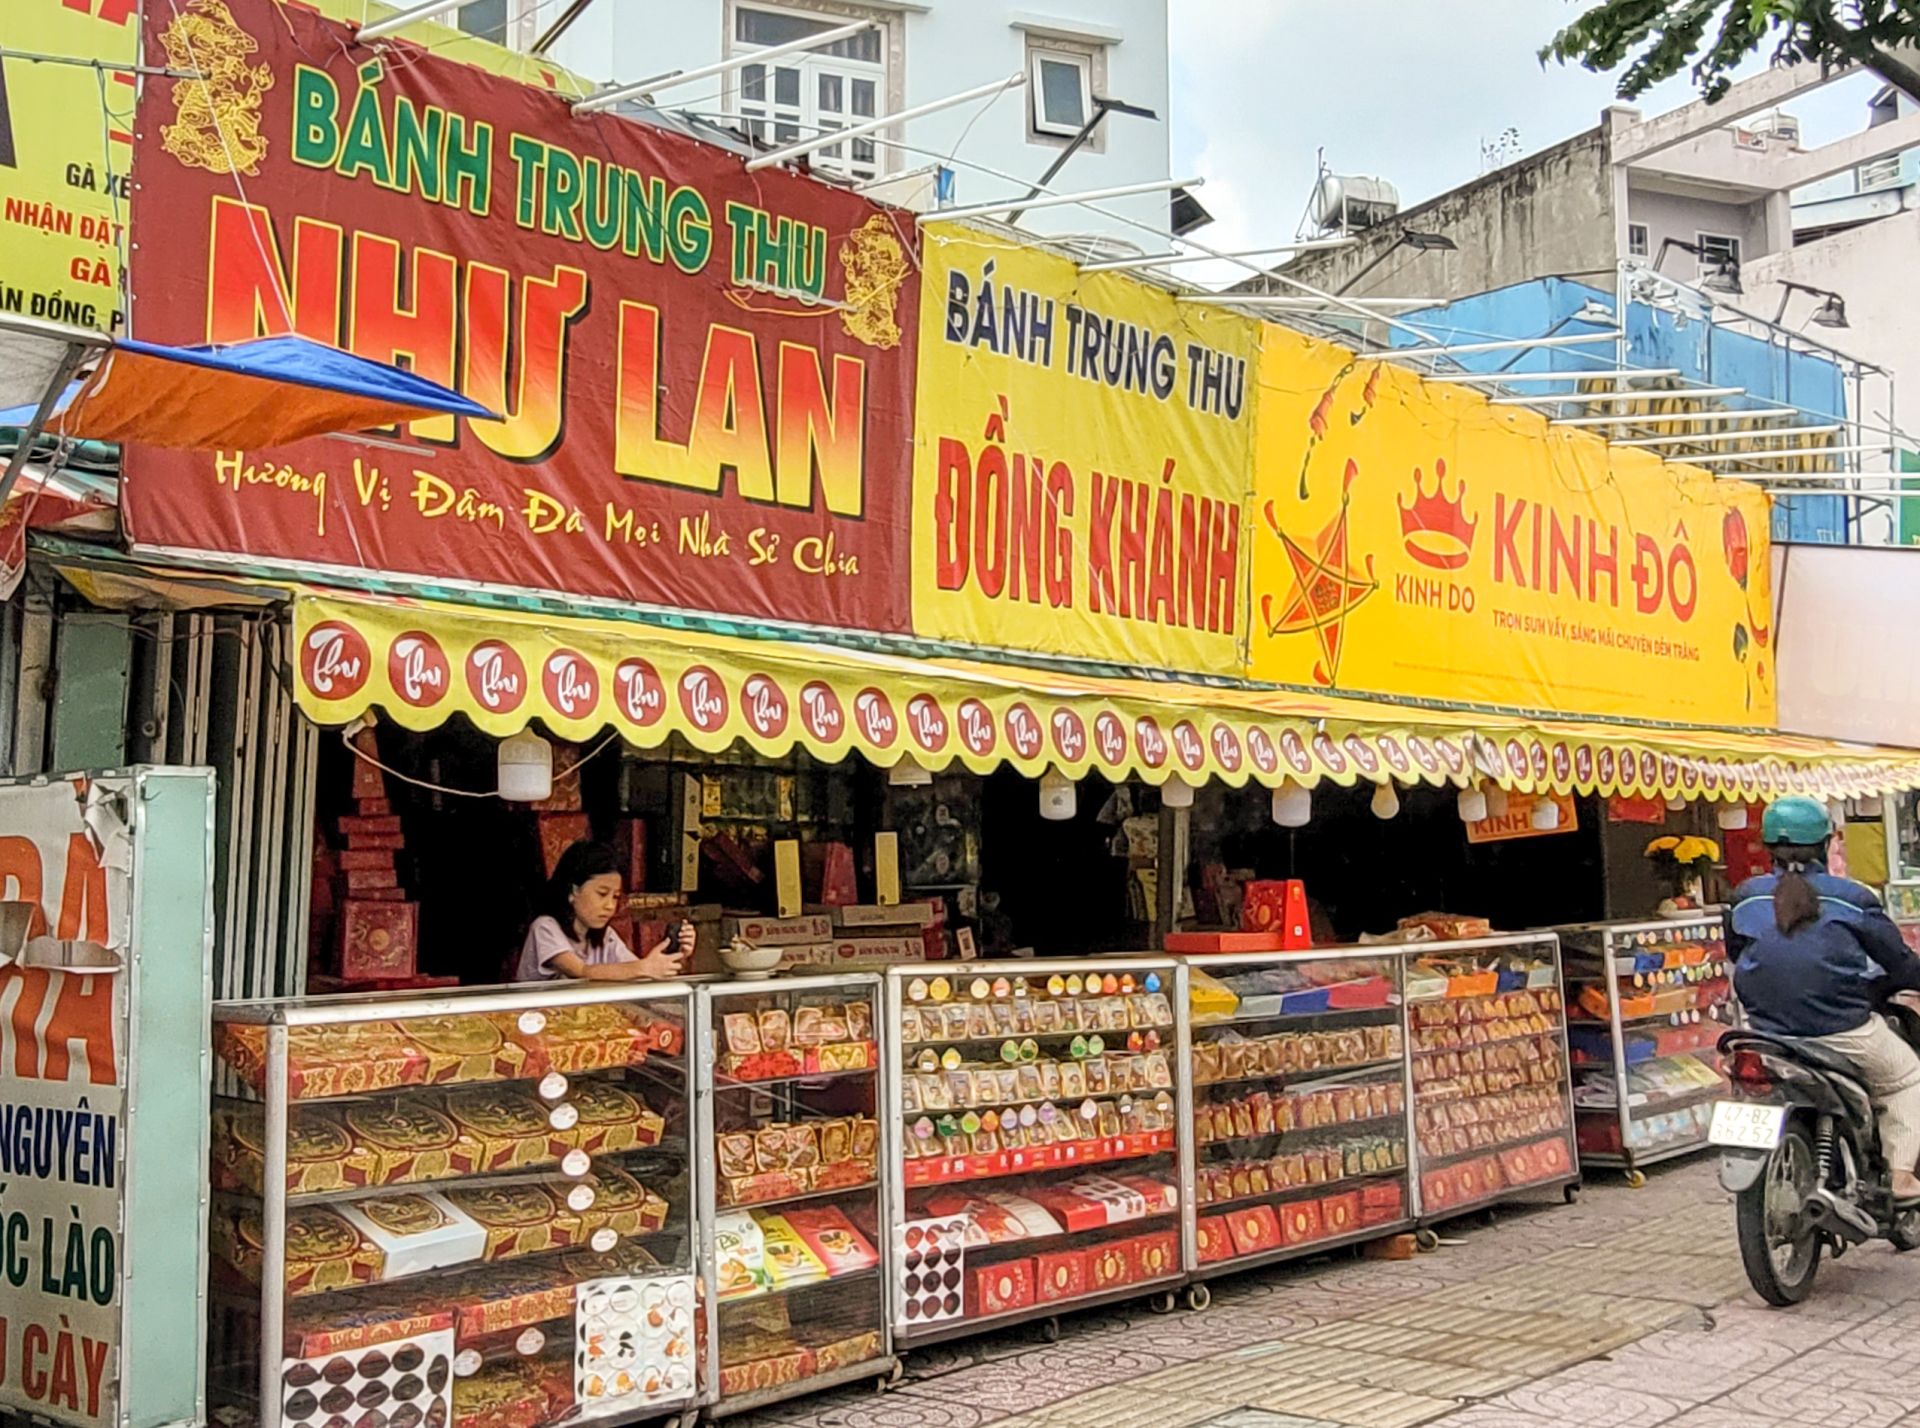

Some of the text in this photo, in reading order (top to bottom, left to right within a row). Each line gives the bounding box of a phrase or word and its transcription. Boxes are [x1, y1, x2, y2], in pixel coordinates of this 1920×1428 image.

[5, 197, 124, 249] NHẬN ĐẶT
[66, 161, 96, 192] GÀ
[291, 57, 827, 307] BÁNH TRUNG THU
[70, 256, 111, 288] GÀ
[207, 194, 865, 517] NHƯ LAN
[944, 255, 1247, 421] BÁNH TRUNG THU
[215, 449, 327, 537] Hương
[353, 458, 392, 511] Vị
[410, 469, 504, 531] Đậm
[606, 502, 661, 549] Mọi
[679, 510, 731, 558] Nhà
[792, 532, 860, 577] Chia
[934, 394, 1241, 635] ĐỒNG KHÁNH
[1494, 491, 1698, 624] KINH ĐÔ
[1395, 573, 1476, 615] KINH DO
[1493, 609, 1521, 634] TRỌN
[42, 1205, 115, 1306] LÀO
[22, 1314, 108, 1418] CÀY
